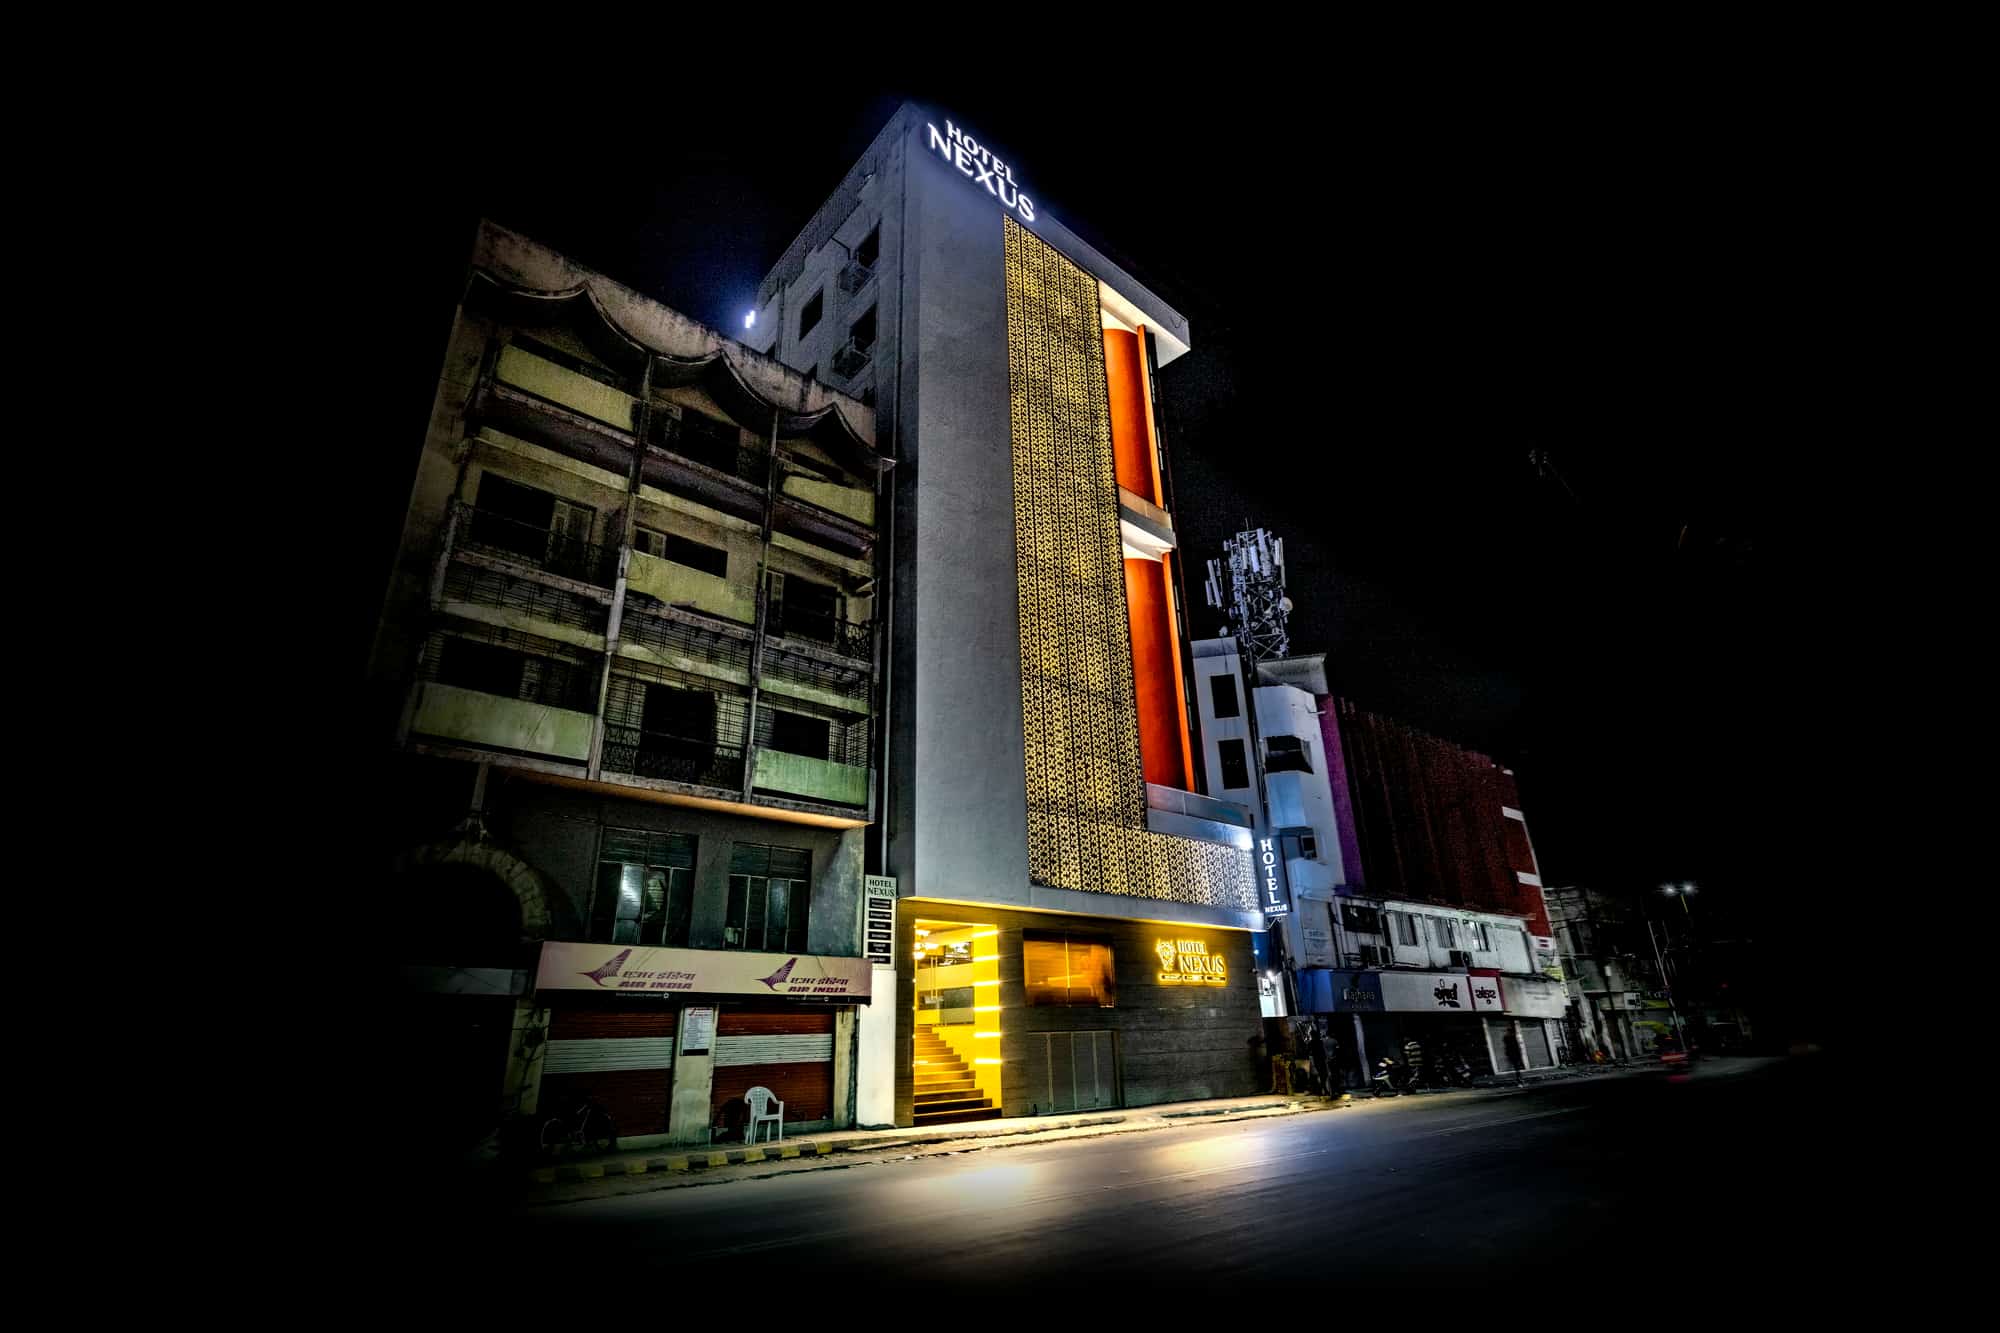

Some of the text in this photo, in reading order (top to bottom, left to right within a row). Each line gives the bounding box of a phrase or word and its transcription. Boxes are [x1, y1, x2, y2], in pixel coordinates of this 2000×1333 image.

[946, 119, 1019, 188] HOTEL
[927, 122, 1035, 222] NEXUS
[1261, 838, 1281, 905] HOTEL
[869, 879, 893, 888] HOTEL
[868, 888, 895, 897] NEXUS
[1178, 941, 1207, 954] HOTEL
[1180, 955, 1226, 974] NEXUS
[650, 981, 693, 989] INDIA
